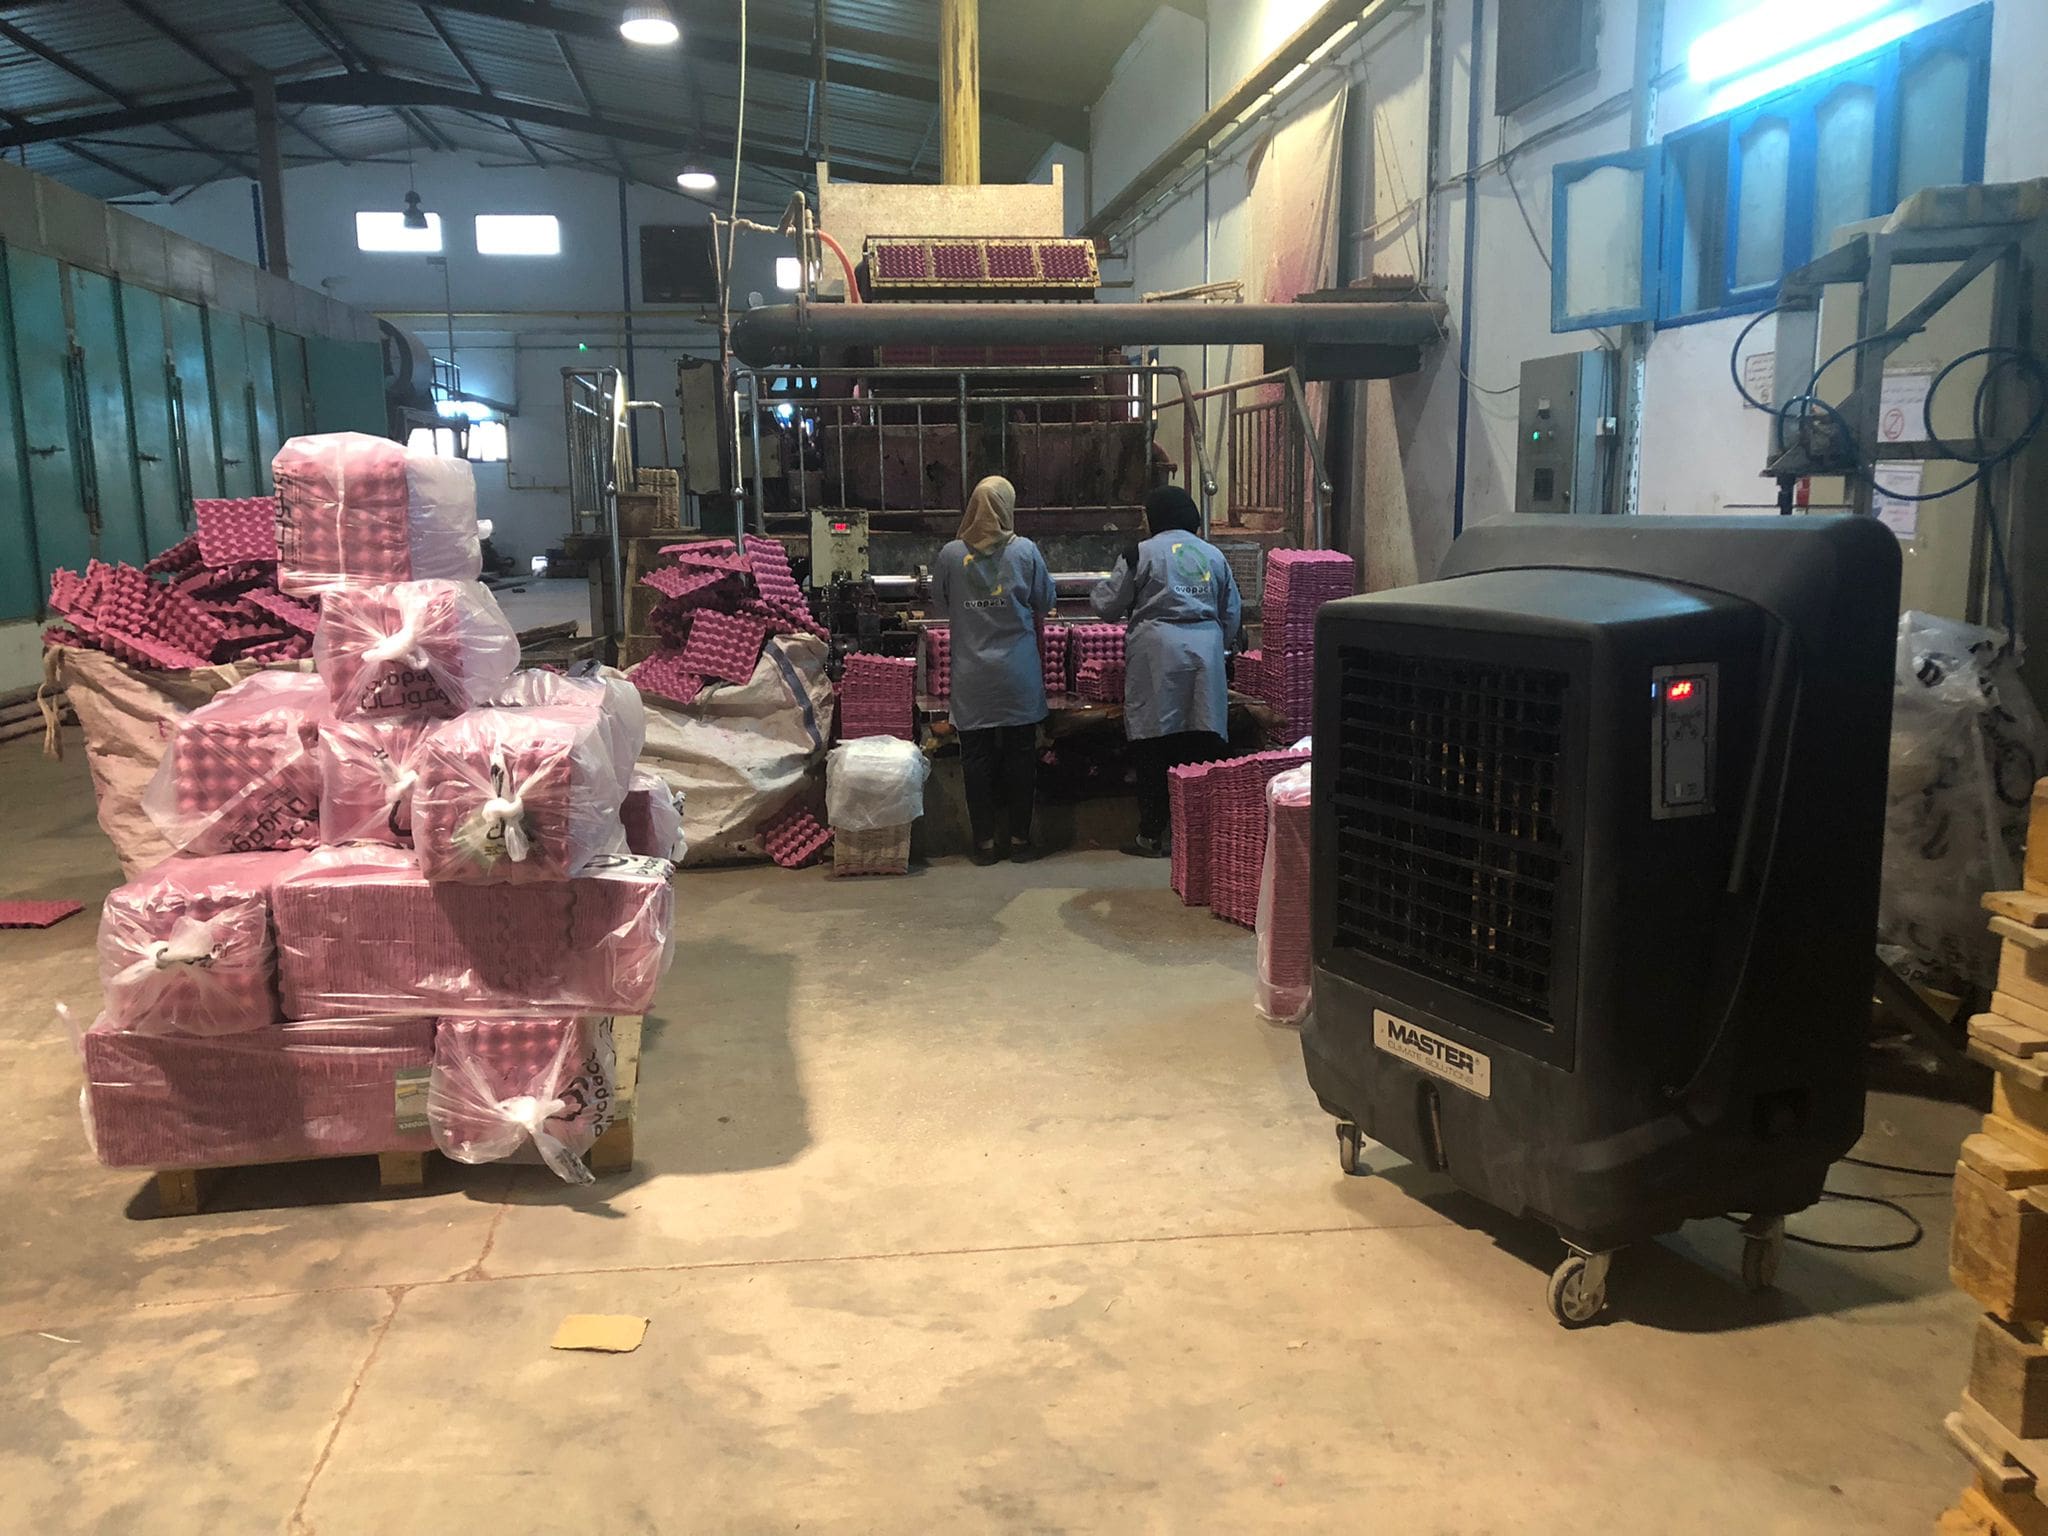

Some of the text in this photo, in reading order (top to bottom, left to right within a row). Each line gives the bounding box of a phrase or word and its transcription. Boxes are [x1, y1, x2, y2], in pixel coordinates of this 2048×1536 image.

[1387, 1019, 1474, 1074] MASTER
[1387, 1039, 1474, 1085] CLIMATE SOLUTIONS
